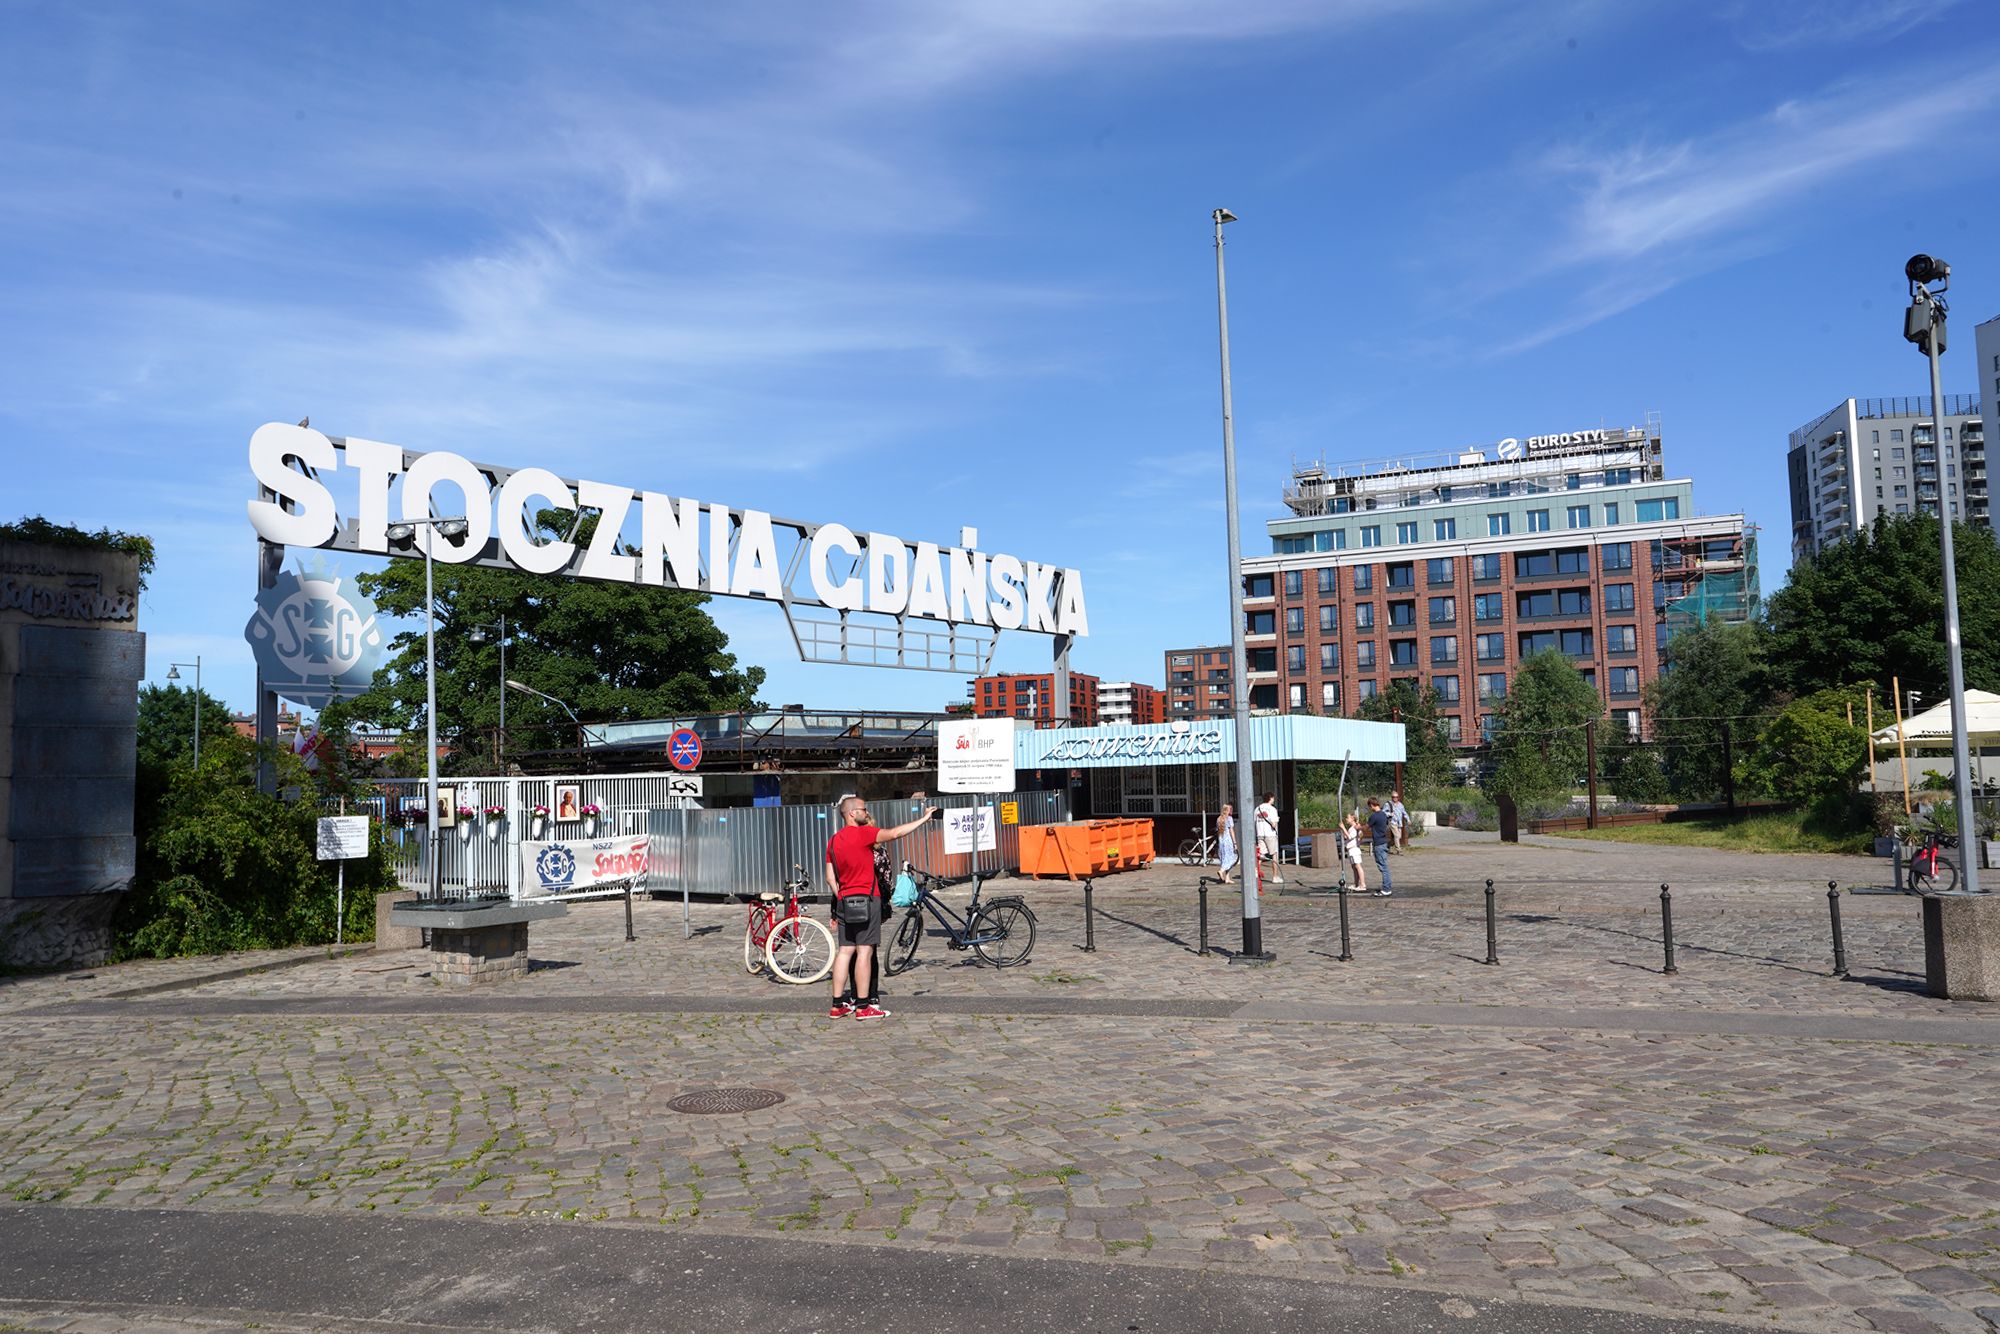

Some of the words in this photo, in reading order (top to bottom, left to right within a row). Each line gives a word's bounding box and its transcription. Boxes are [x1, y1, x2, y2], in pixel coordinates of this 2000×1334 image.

[1529, 433, 1570, 449] EURO
[1572, 429, 1609, 444] STYL
[248, 422, 785, 600] STOCZNIA
[809, 523, 1089, 637] GDAŃSKA
[977, 738, 995, 749] BHP
[592, 842, 613, 850] NSZZ
